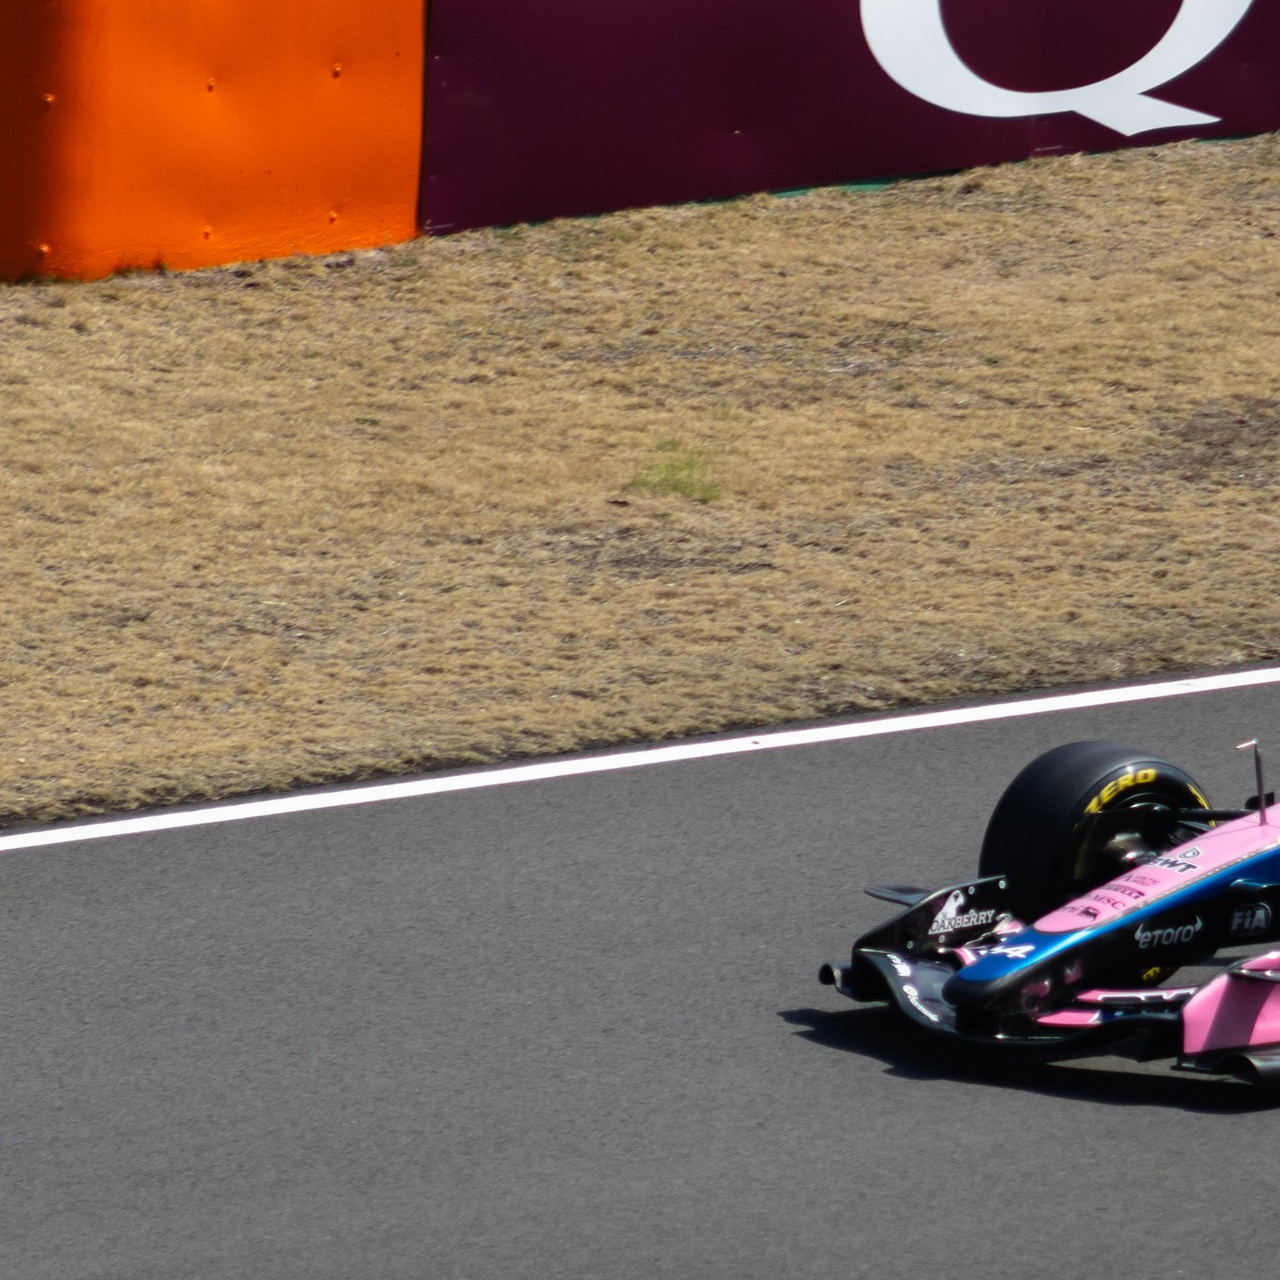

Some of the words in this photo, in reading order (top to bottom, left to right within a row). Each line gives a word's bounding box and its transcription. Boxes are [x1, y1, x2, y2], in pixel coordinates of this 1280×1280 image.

[1084, 768, 1157, 814] ZERO
[1091, 894, 1126, 911] MSC
[930, 909, 996, 933] OAKBERRY
[1232, 909, 1267, 931] FIA
